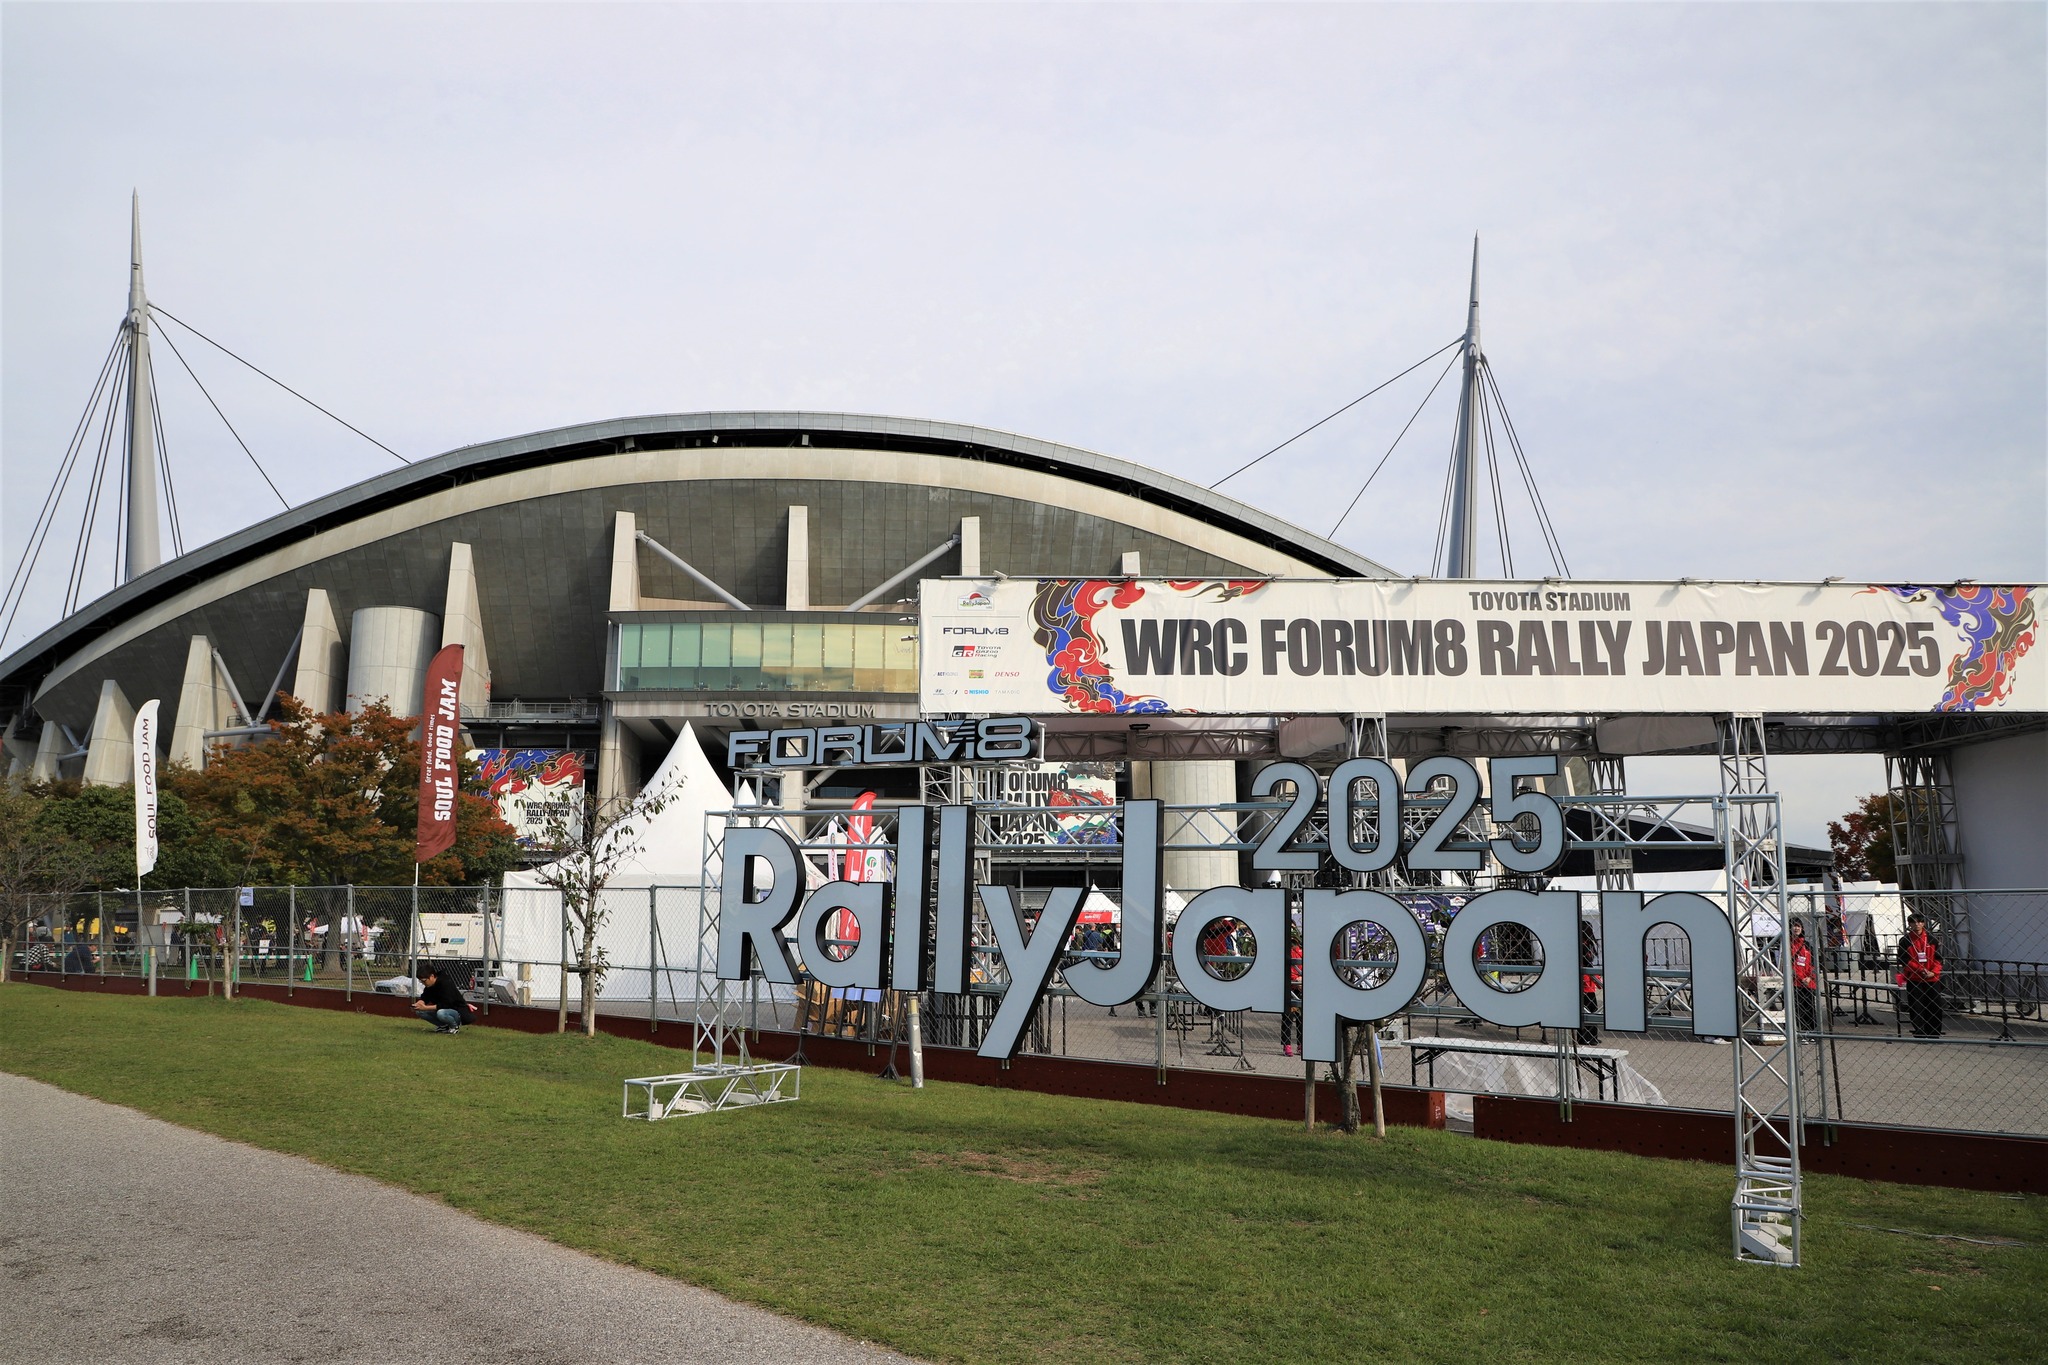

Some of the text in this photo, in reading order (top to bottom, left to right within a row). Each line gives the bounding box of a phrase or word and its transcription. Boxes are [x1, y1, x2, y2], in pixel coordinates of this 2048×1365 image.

[1469, 591, 1630, 611] TOYOTA STADIUM
[1120, 618, 1941, 677] WRC FORUM8 RALLY JAPAN 2025
[704, 701, 877, 718] TOYOTA STADIUM
[142, 718, 150, 750] JAM
[426, 731, 434, 748] Good
[727, 717, 1038, 768] FORUM8
[434, 678, 457, 821] SOUL FOOD JAM
[142, 752, 153, 795] FOOD
[424, 765, 433, 784] Great
[526, 801, 543, 809] WRC
[1250, 755, 1567, 872] 2025
[526, 817, 543, 825] 2025
